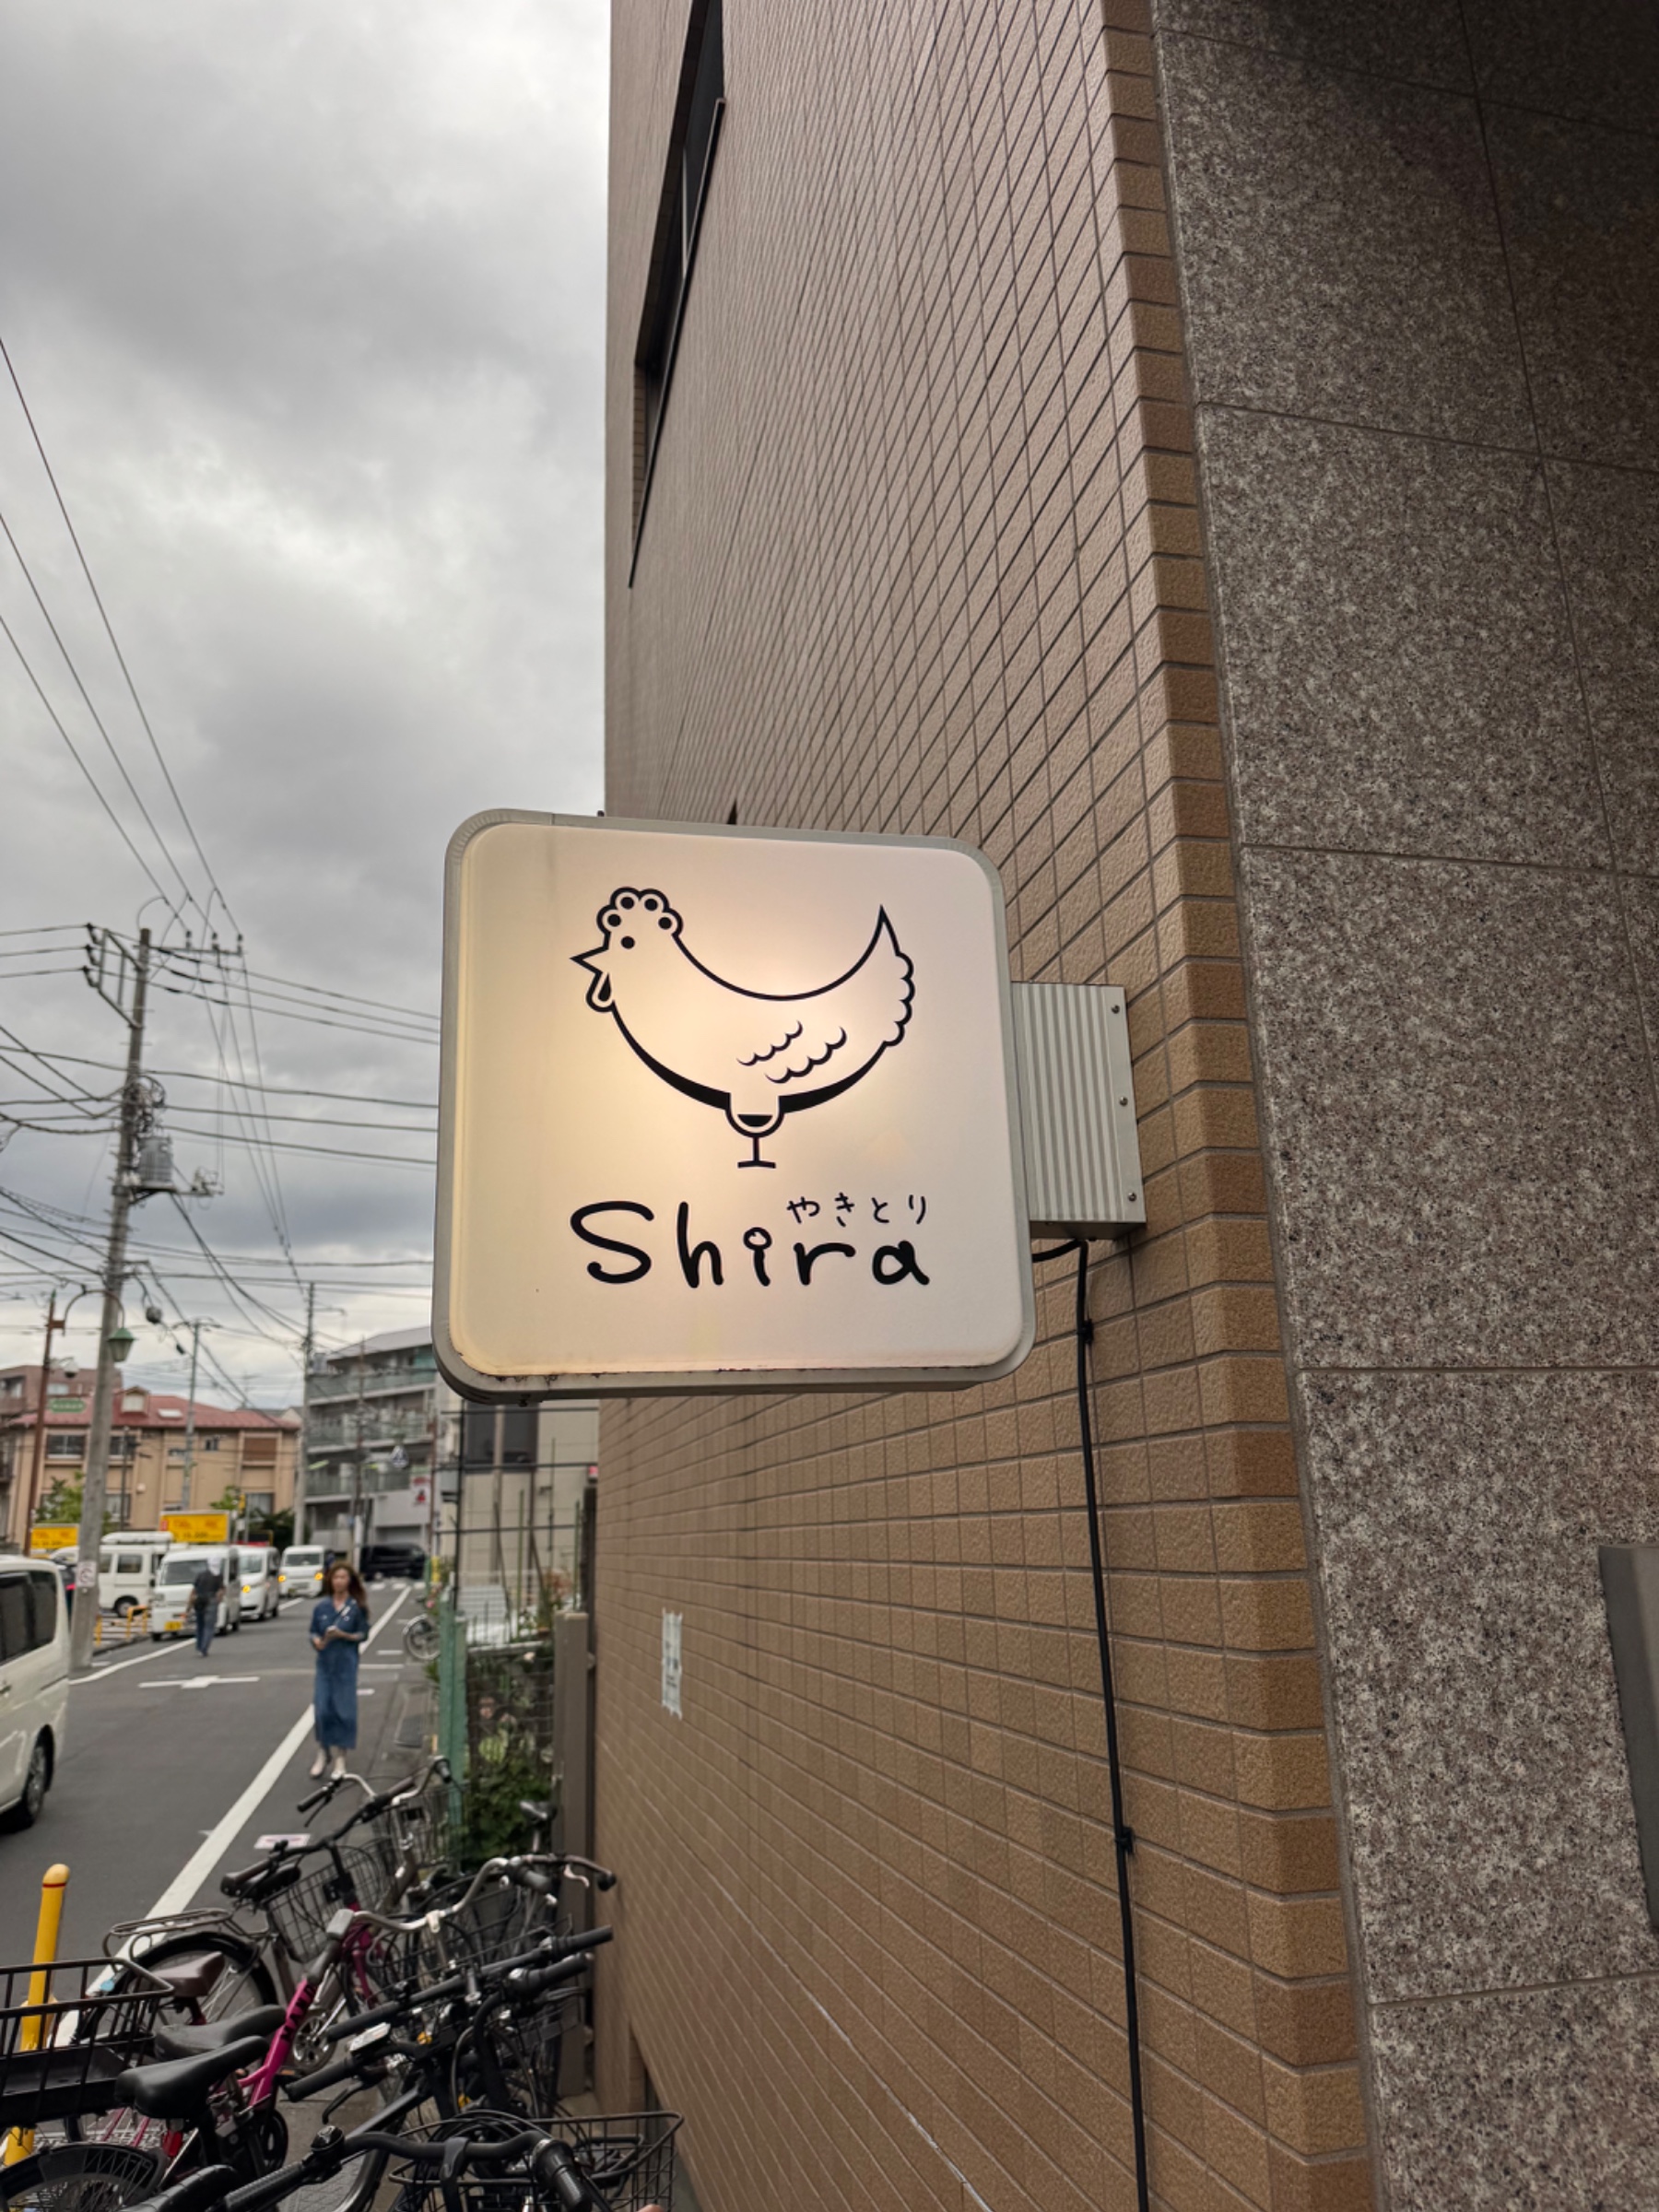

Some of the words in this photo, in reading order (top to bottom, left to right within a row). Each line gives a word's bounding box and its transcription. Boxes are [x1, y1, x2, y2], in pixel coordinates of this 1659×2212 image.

[786, 1192, 926, 1228] やきとり
[570, 1200, 931, 1288] Shira
